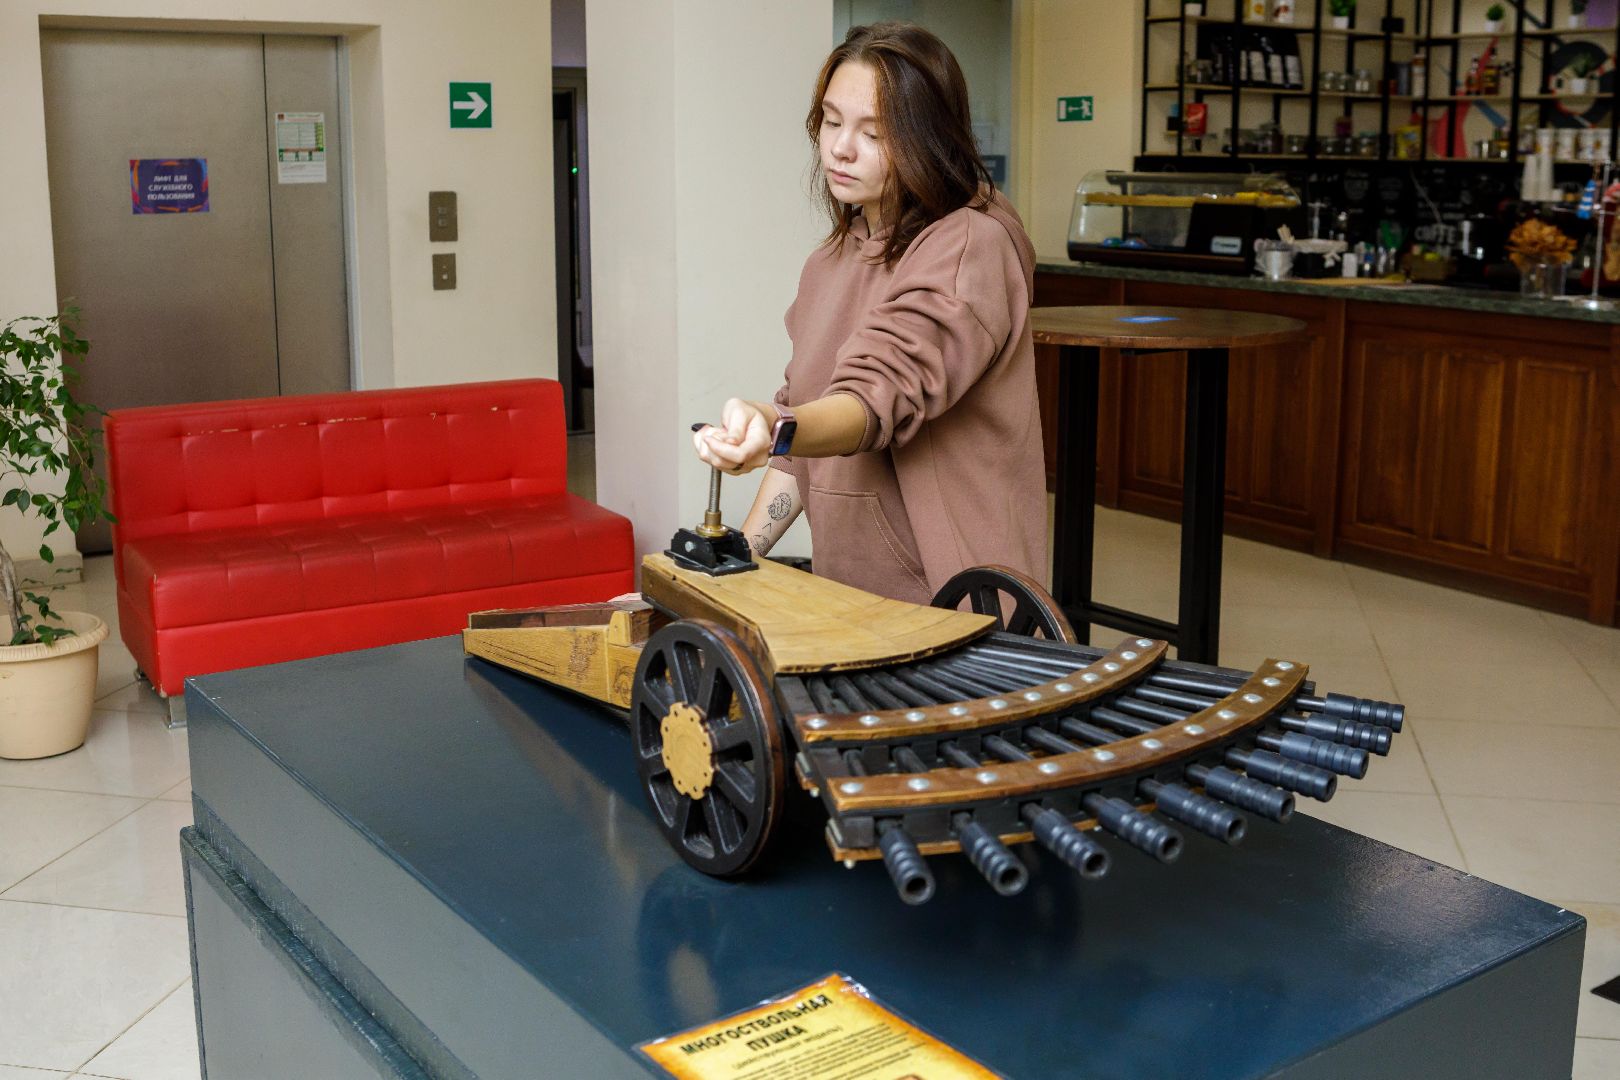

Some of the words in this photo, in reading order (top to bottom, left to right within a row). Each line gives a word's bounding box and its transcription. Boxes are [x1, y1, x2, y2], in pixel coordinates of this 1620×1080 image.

[147, 192, 195, 201] ПОЛЬЗОВАНИЯ
[680, 994, 832, 1055] МНОГОСТВОЛЬНАЯ
[745, 1024, 807, 1051] ПУШКА
